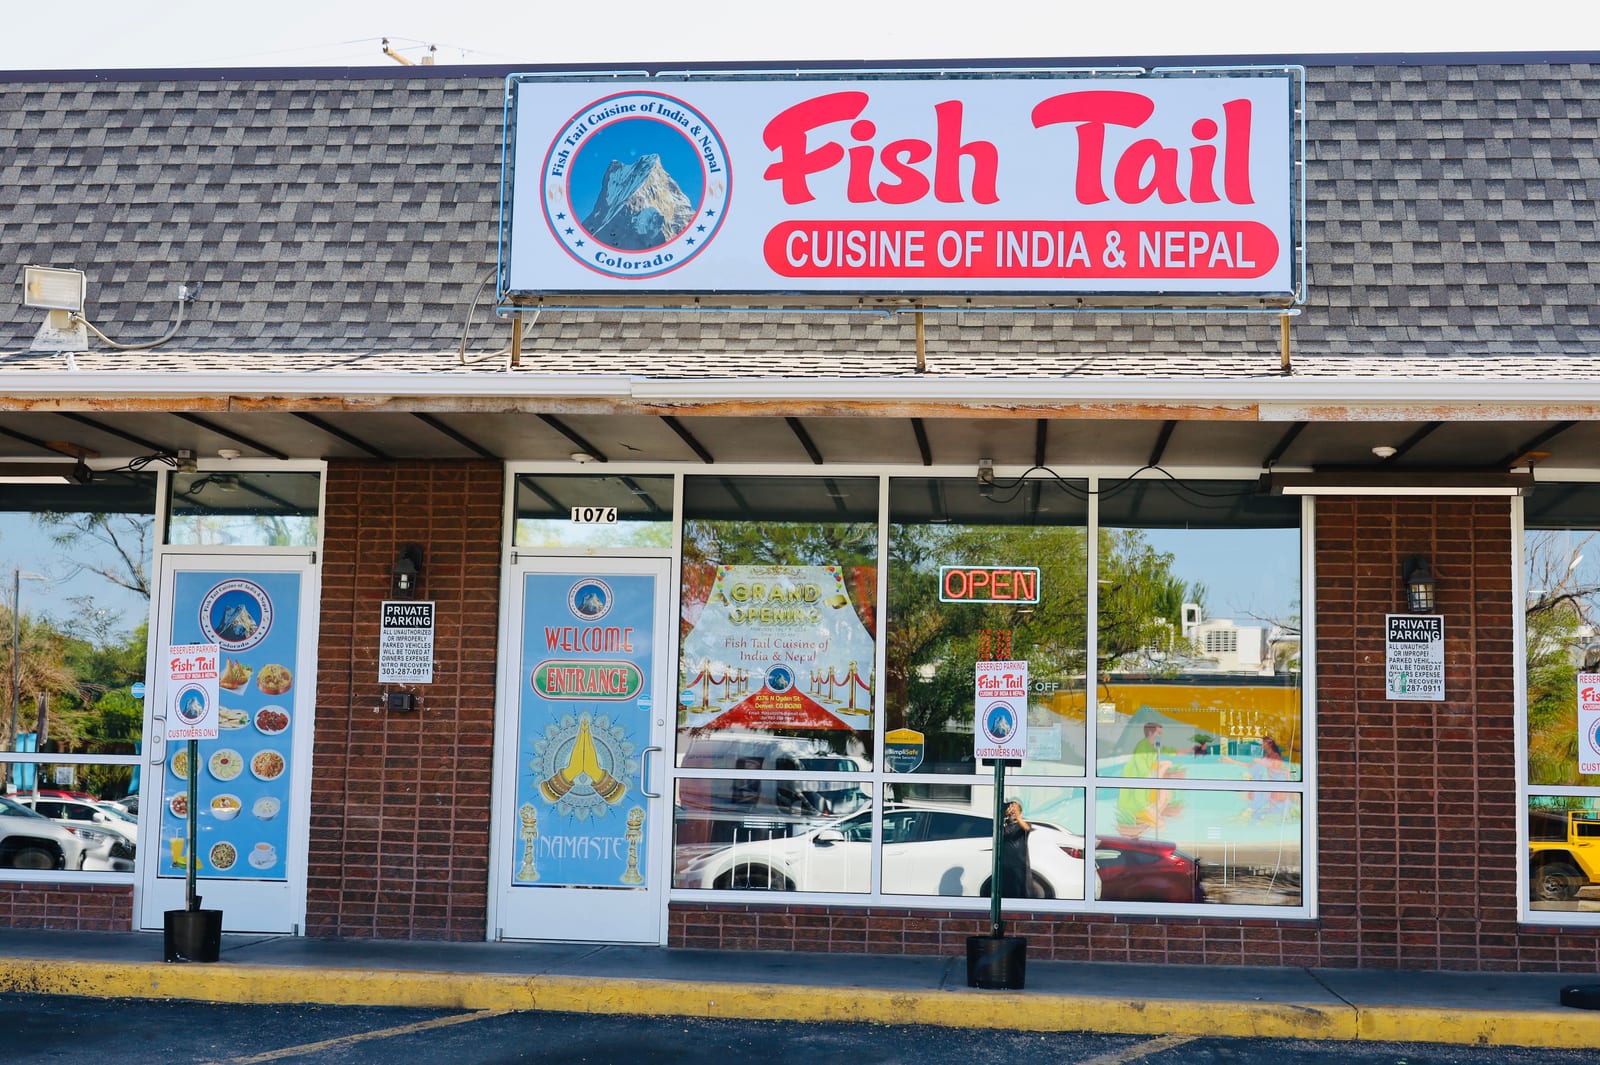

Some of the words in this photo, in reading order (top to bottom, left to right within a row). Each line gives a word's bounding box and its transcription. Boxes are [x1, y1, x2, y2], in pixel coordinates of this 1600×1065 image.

[551, 149, 570, 178] Fish
[564, 122, 589, 148] Tail
[587, 102, 637, 126] Cuisine
[640, 102, 656, 113] of
[656, 102, 690, 128] India
[690, 125, 702, 137] &
[698, 135, 721, 174] Nepal
[763, 91, 1000, 205] Fish
[1031, 90, 1256, 205] Tail
[785, 229, 925, 270] CUISINE
[936, 229, 984, 270] OF
[996, 229, 1091, 270] INDIA
[1102, 229, 1126, 270] &
[1138, 229, 1256, 270] NEPAL
[594, 251, 674, 270] Colorado
[573, 507, 616, 523] 1076
[730, 582, 823, 603] GRAND
[944, 569, 1036, 600] OPEN
[386, 606, 430, 616] PRIVATE
[729, 606, 824, 625] OPENING
[384, 616, 431, 626] PARKING
[1391, 619, 1439, 630] PRIVATE
[544, 626, 635, 653] WELCOME
[1390, 630, 1440, 641] PARKING
[169, 646, 196, 655] RESERVED
[196, 645, 218, 654] PARKING
[724, 637, 748, 649] Fish
[750, 637, 771, 649] Tail
[773, 637, 816, 649] Cuisine
[818, 637, 832, 653] of
[170, 658, 192, 672] Fish
[195, 656, 215, 671] Tail
[739, 650, 769, 661] India
[772, 651, 782, 661] &
[785, 650, 818, 664] Nepal
[976, 662, 1002, 671] RESERVED
[1004, 662, 1025, 670] PARKING
[546, 667, 628, 694] ENTRANCE
[978, 674, 1000, 689] Fish
[1002, 673, 1023, 689] Tail
[1036, 682, 1059, 692] OFF
[168, 729, 202, 738] CUSTOMERS
[204, 728, 218, 737] ONLY
[976, 748, 1010, 757] CUSTOMERS
[1011, 748, 1026, 757] ONLY
[539, 835, 627, 860] NAMASTE
